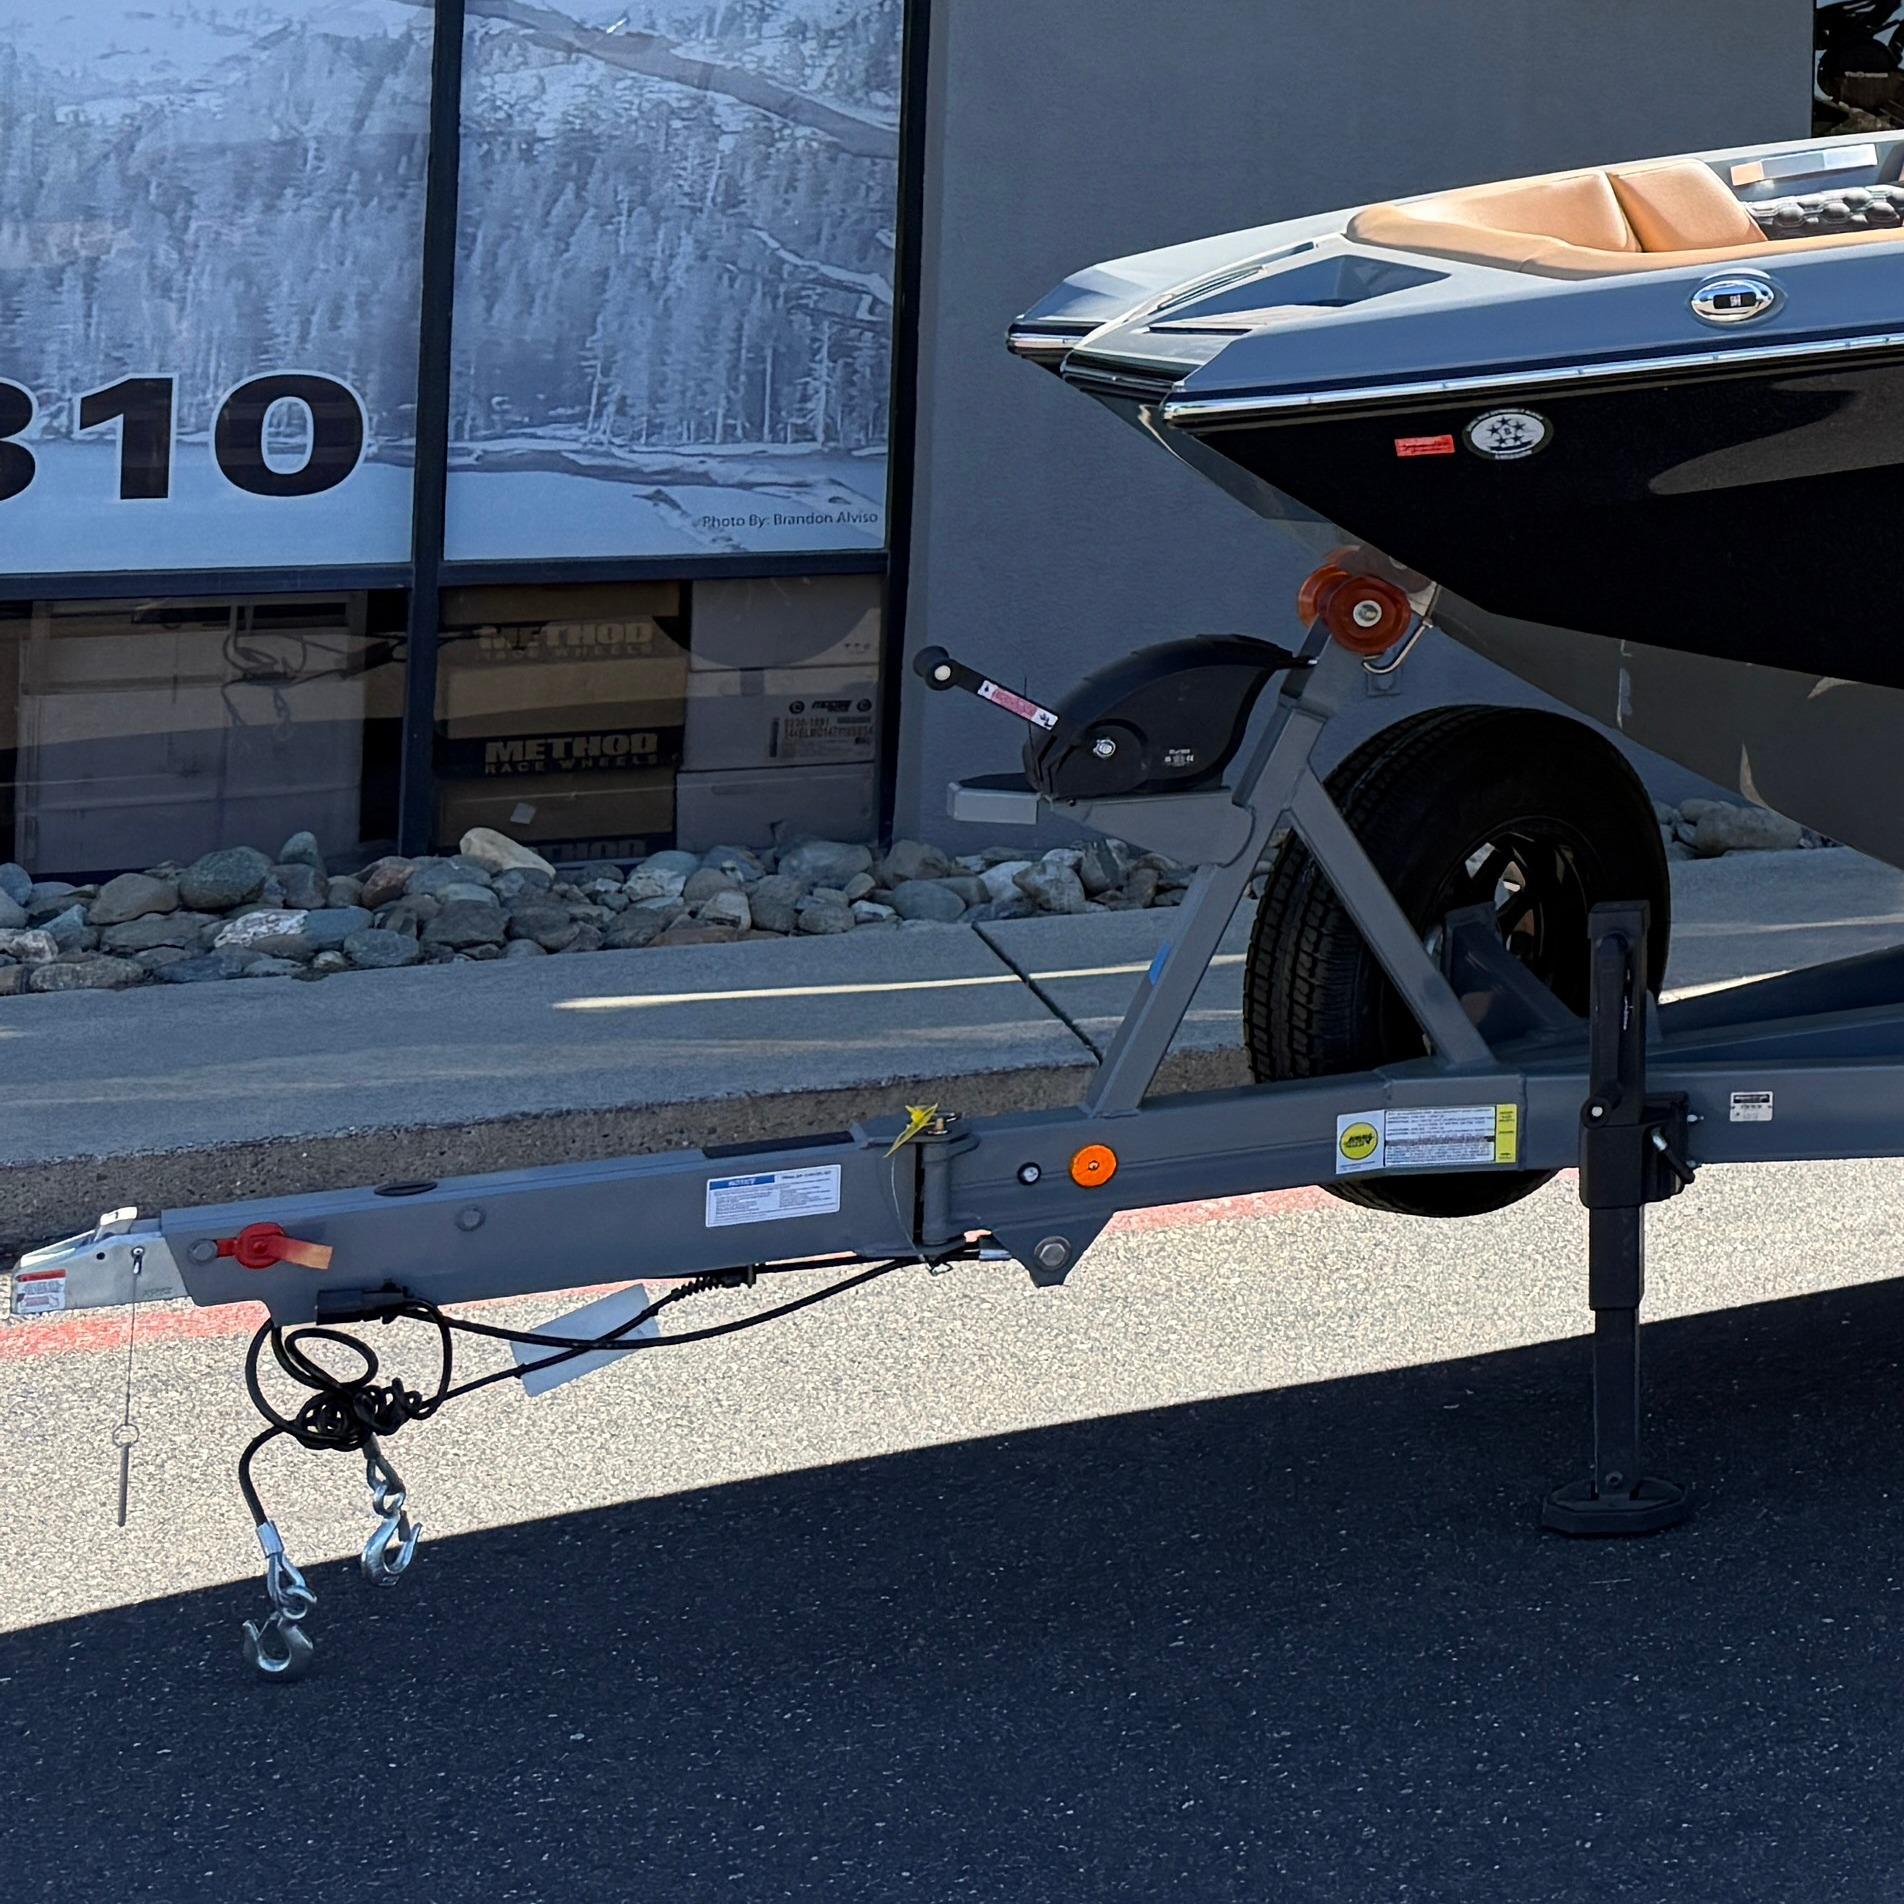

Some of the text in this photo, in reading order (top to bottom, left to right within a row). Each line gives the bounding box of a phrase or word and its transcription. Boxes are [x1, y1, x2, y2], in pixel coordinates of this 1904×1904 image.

[0, 372, 364, 501] 10
[702, 511, 878, 529] Photo By: Brandon Alviso
[484, 732, 659, 764] METHOD
[484, 761, 545, 775] RACE
